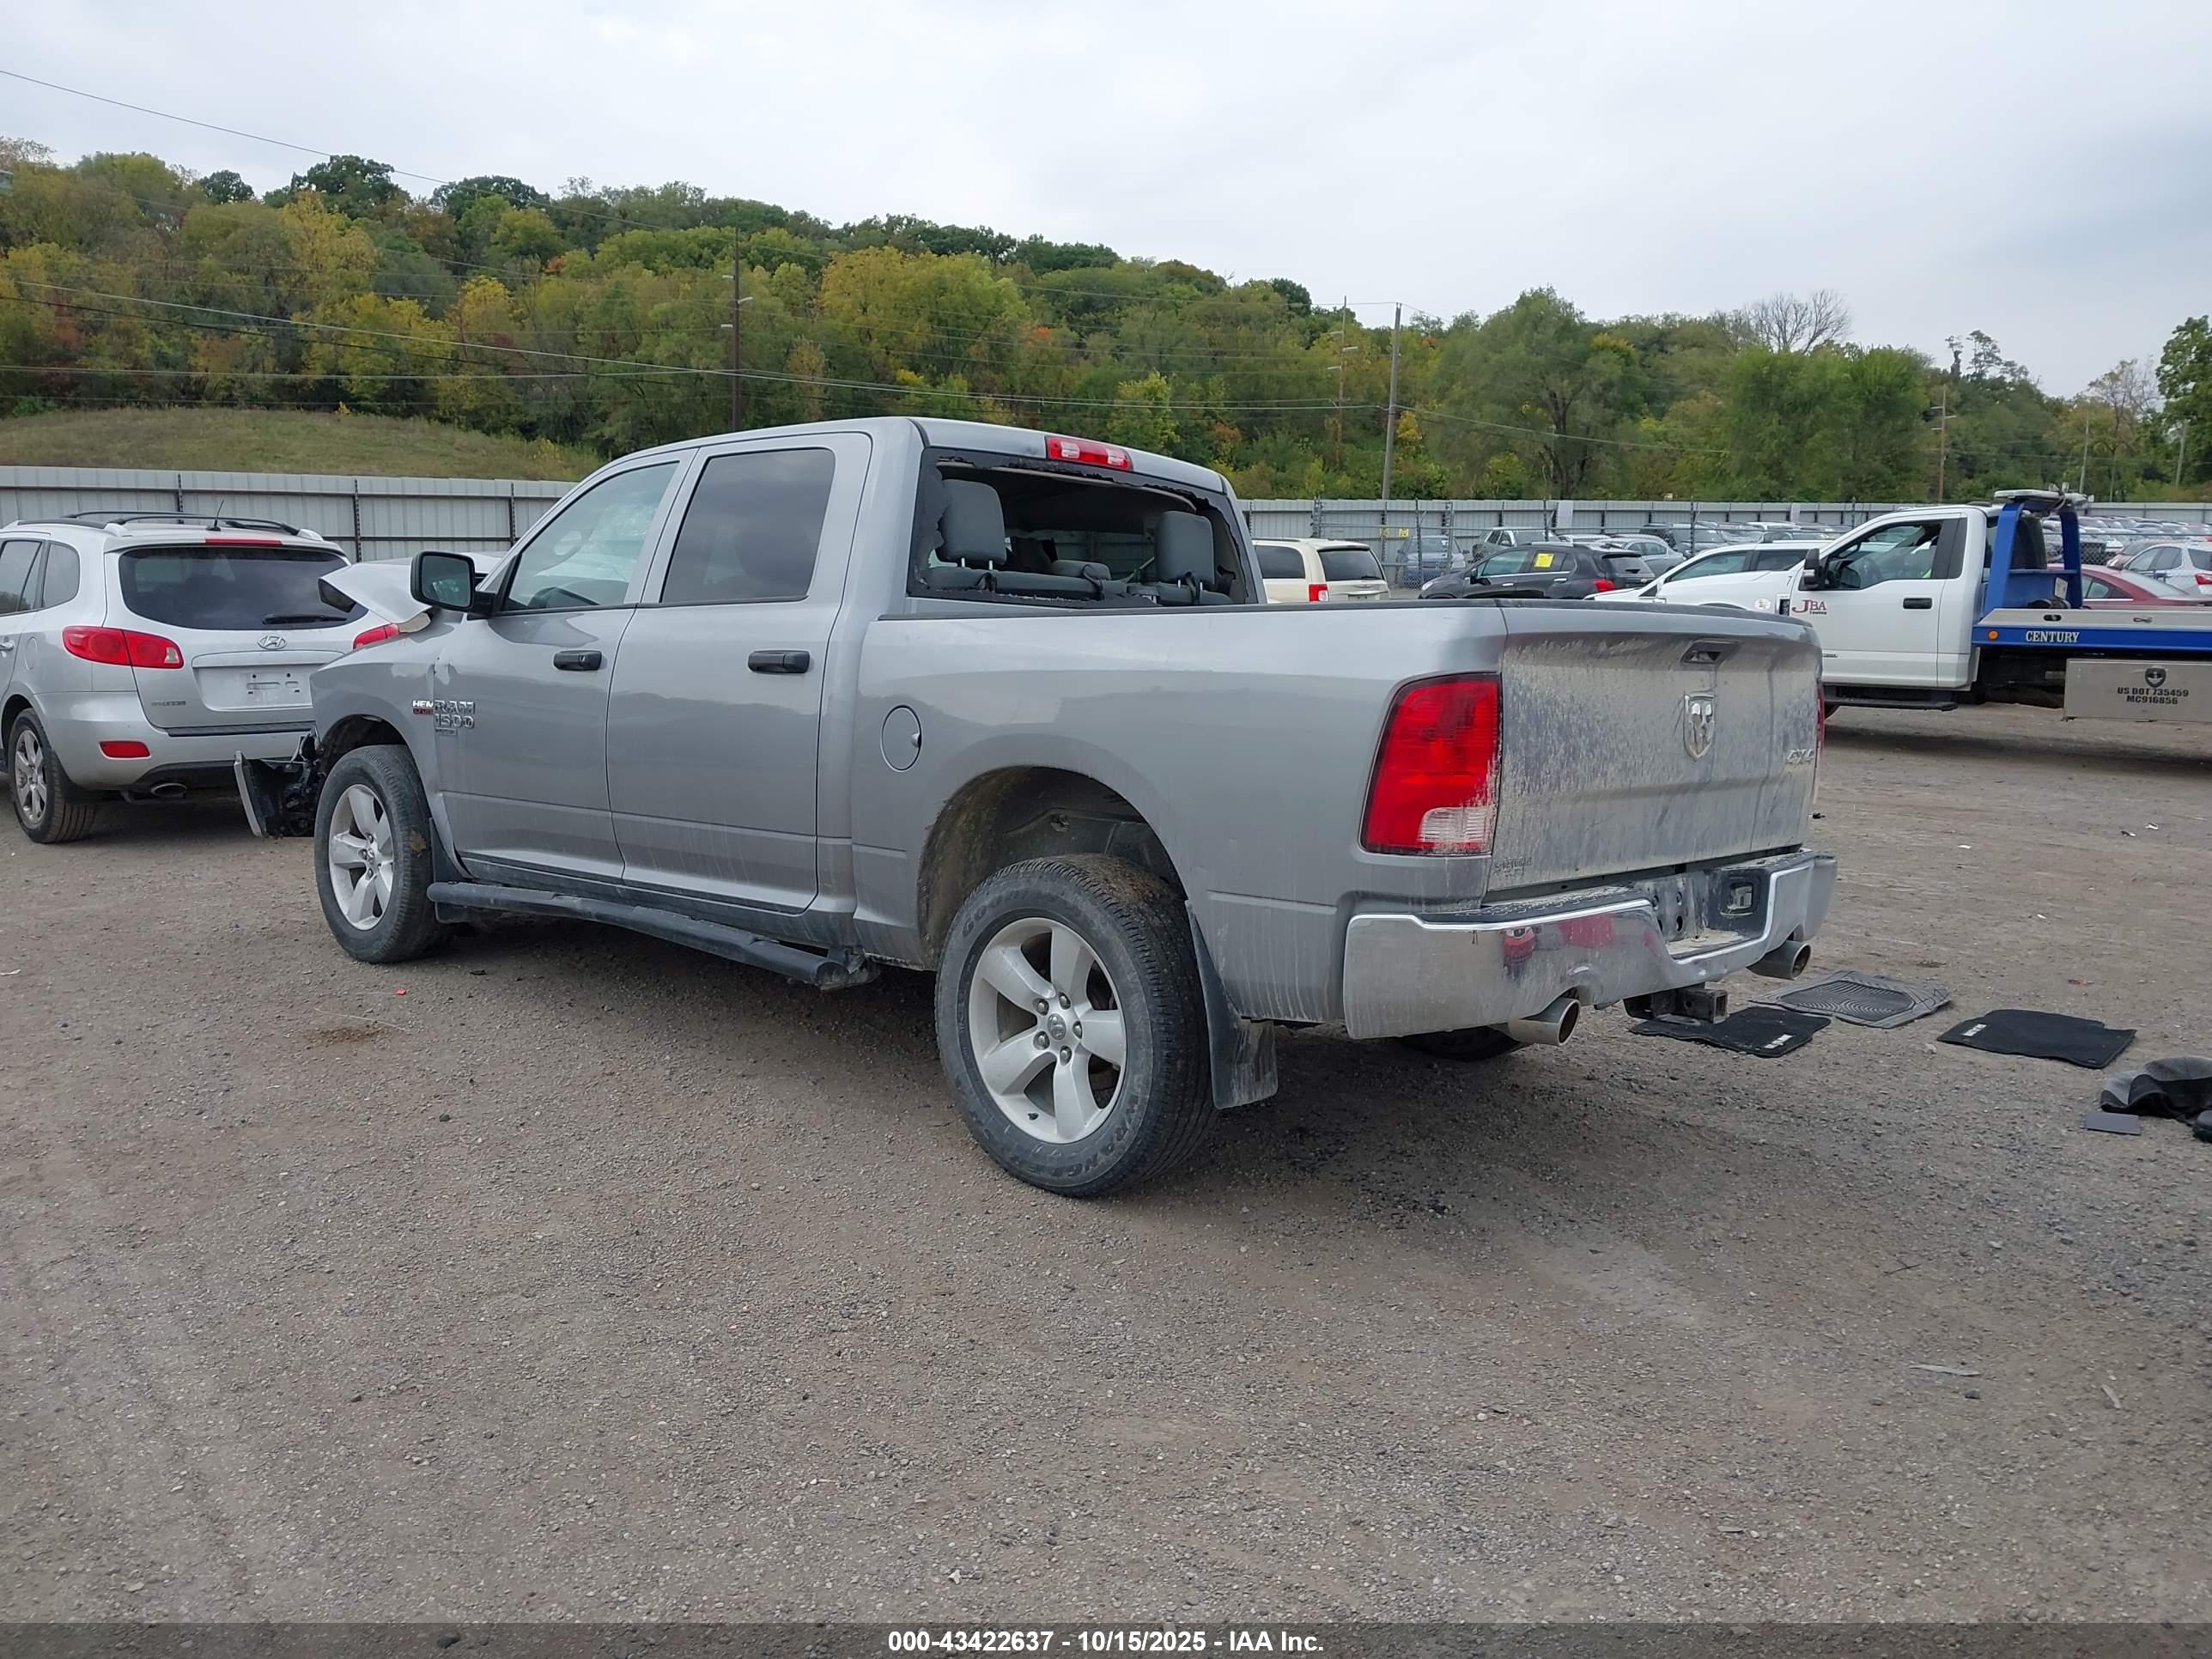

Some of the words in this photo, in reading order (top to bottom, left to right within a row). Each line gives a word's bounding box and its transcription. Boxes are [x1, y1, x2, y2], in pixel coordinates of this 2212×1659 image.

[1791, 599, 1827, 613] JBA
[2026, 630, 2081, 643] CENTURY
[2117, 686, 2130, 695] US
[2131, 687, 2150, 696] DOT
[2152, 688, 2190, 697] 735459
[434, 699, 476, 714] RAM
[2126, 695, 2179, 705] MC916856
[434, 713, 475, 729] 1500
